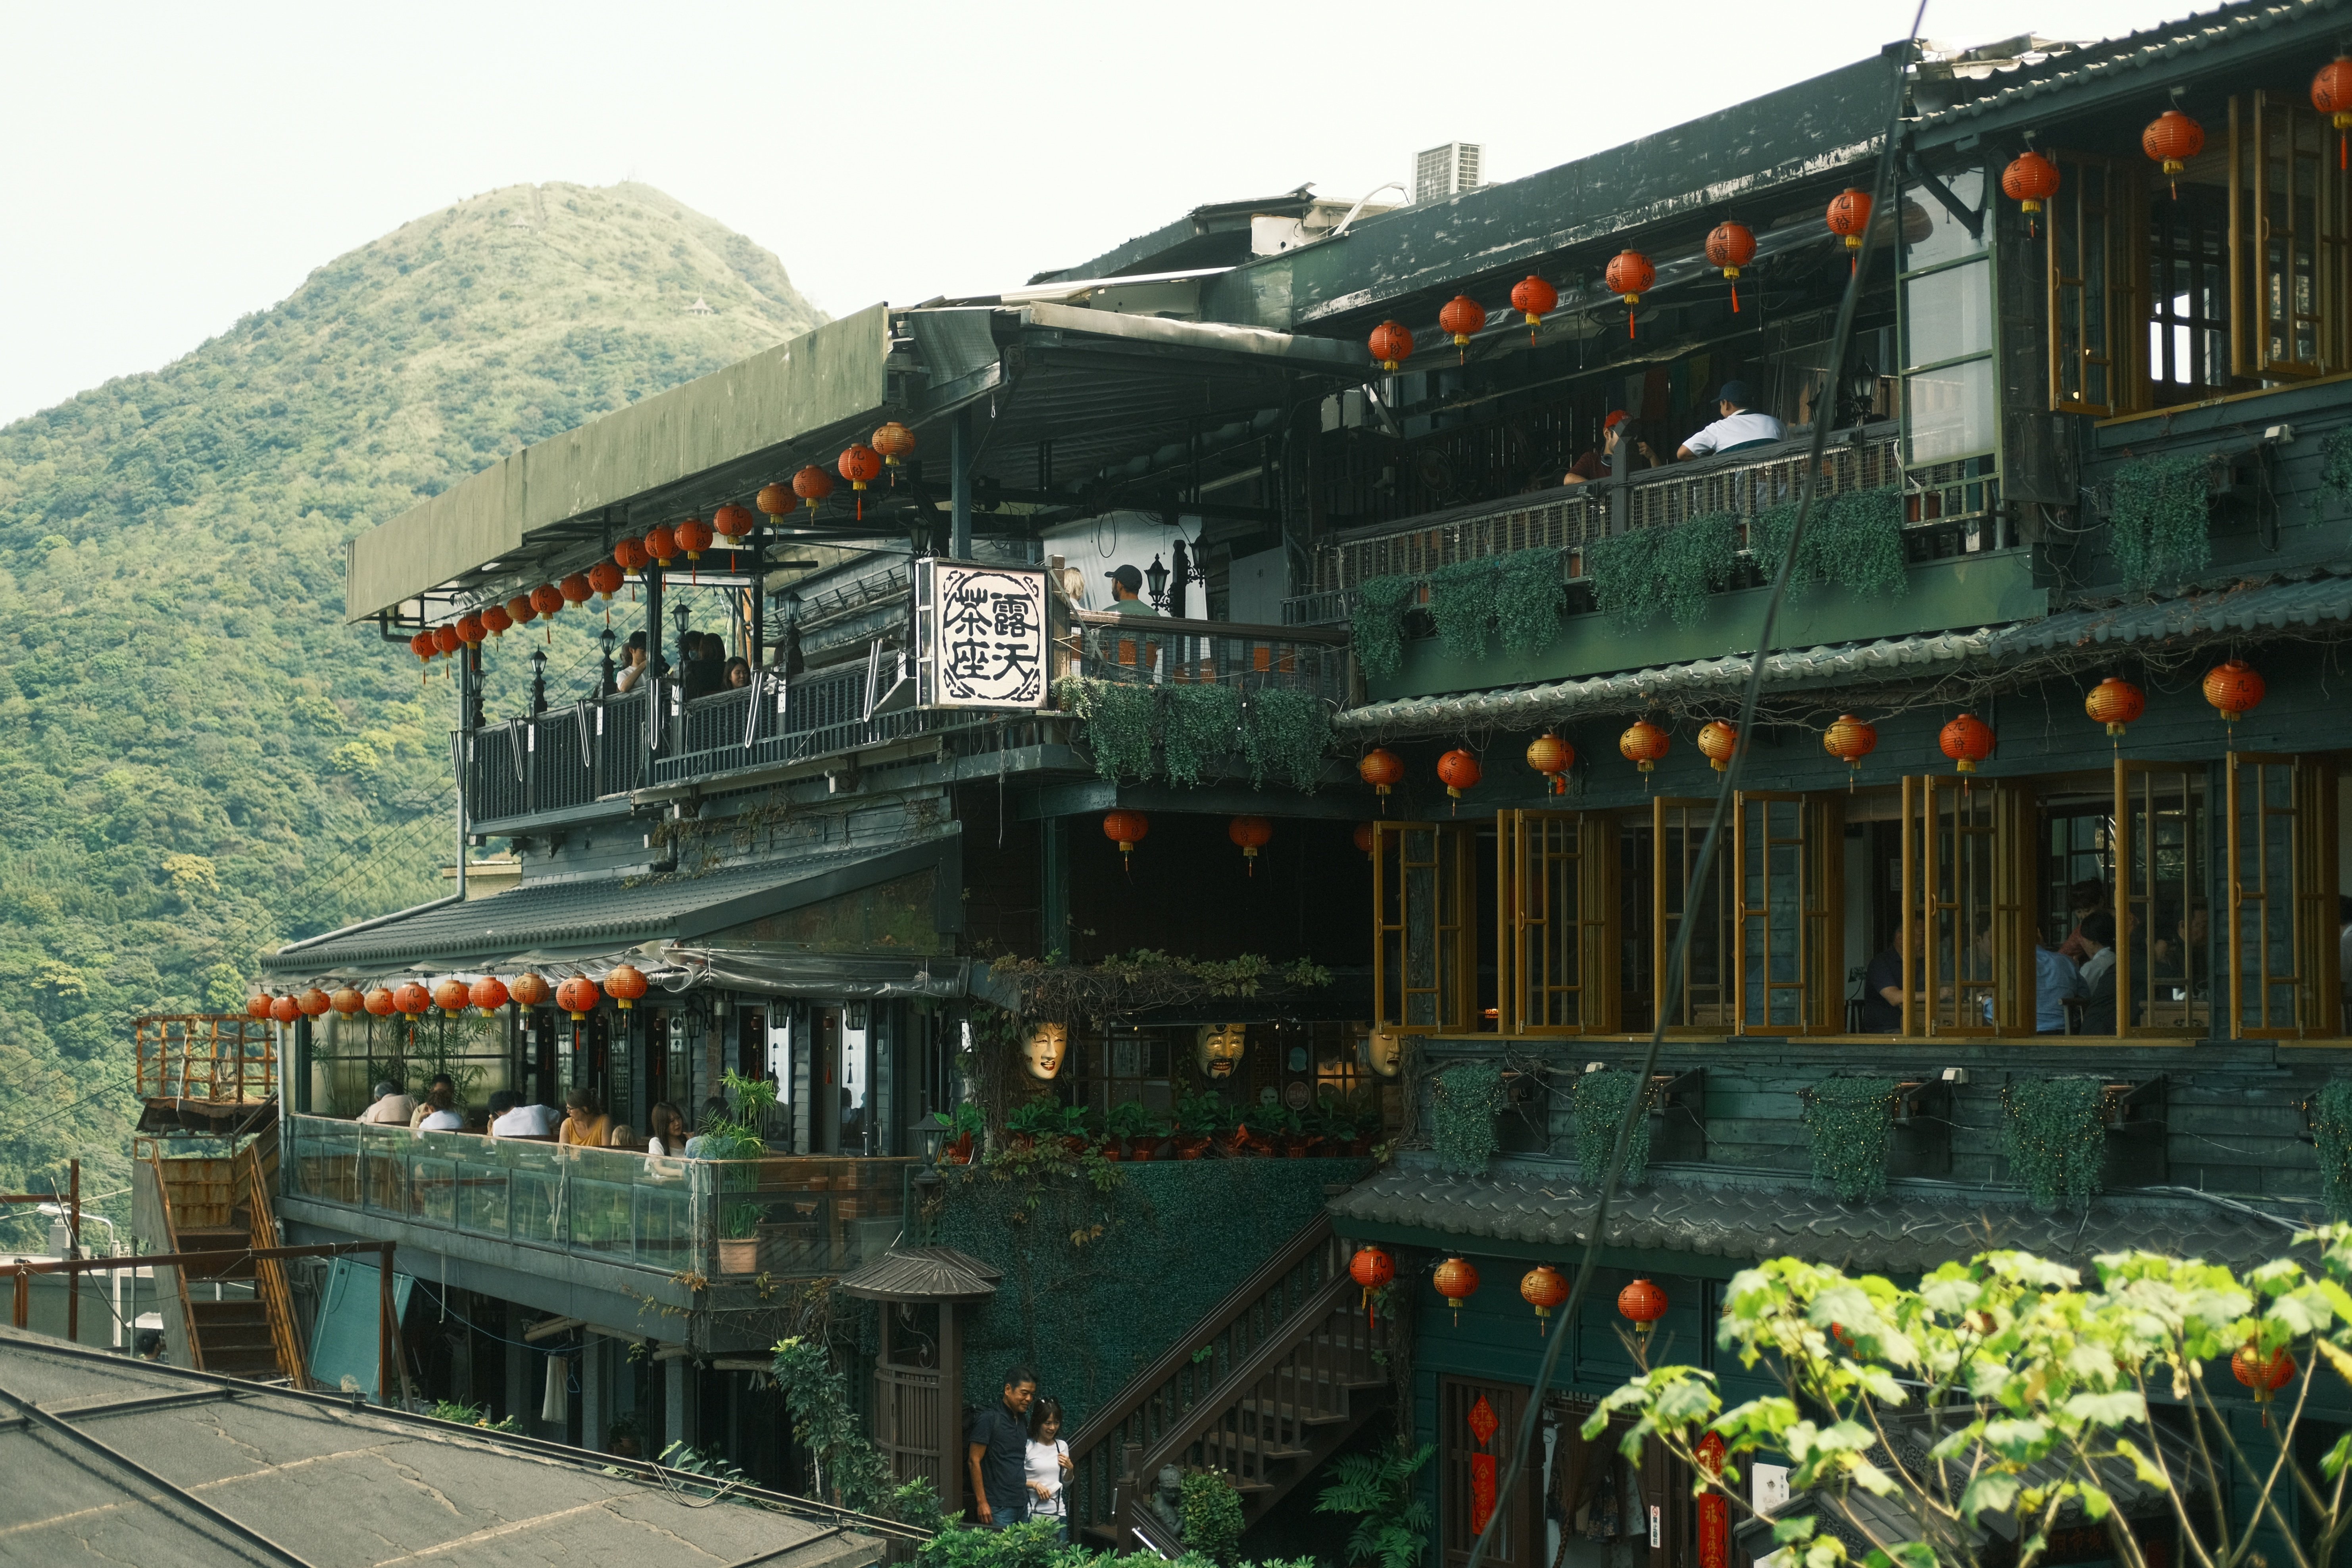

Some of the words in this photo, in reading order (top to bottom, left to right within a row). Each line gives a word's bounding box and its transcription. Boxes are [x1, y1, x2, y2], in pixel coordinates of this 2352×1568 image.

[2146, 120, 2157, 151] 九份
[2011, 160, 2020, 191] 九份
[1835, 197, 1849, 230] 九份
[1714, 228, 1727, 260] 九份
[1610, 259, 1622, 287] 九份
[1641, 257, 1652, 286] 九份
[1519, 282, 1529, 306] 九份
[1469, 302, 1478, 326] 九份
[1389, 326, 1402, 355] 九份
[876, 429, 883, 450] 九份
[852, 451, 865, 477] 九份
[799, 471, 806, 492] 九份
[780, 489, 787, 508] 九份
[732, 509, 743, 532] 九份
[648, 533, 657, 555] 九份
[696, 524, 705, 547] 九份
[628, 542, 638, 564] 九份
[594, 569, 602, 590] 九份
[540, 589, 548, 610] 九份
[469, 619, 477, 639] 九份
[489, 609, 496, 627] 九份
[417, 636, 425, 654] 九份
[947, 588, 992, 680] 茶座
[990, 592, 1038, 683] 露天
[2089, 688, 2098, 716] 九份
[2127, 686, 2137, 715] 九份
[2236, 680, 2248, 709] 九份
[1623, 729, 1631, 754] 九份
[1654, 729, 1664, 753] 九份
[1700, 730, 1709, 752] 九份
[1862, 724, 1871, 749] 九份
[1954, 723, 1965, 750] 九份
[1528, 743, 1536, 768] 九份
[1445, 756, 1457, 781] 九份
[1132, 814, 1139, 836] 九份
[1239, 817, 1249, 840] 九份
[492, 984, 500, 1004] 九份
[519, 981, 528, 1000] 九份
[637, 972, 644, 995] 九份
[254, 999, 259, 1015] 九份
[317, 995, 324, 1012] 九份
[351, 992, 358, 1009] 九份
[380, 995, 388, 1013] 九份
[408, 988, 419, 1011] 九份
[451, 987, 459, 1006] 九份
[563, 984, 576, 1008] 九份
[291, 1001, 299, 1021] 九份
[1373, 1256, 1386, 1284] 九份
[1435, 1268, 1443, 1293] 九份
[1464, 1268, 1473, 1293] 九份
[1524, 1276, 1533, 1301] 九份
[1555, 1280, 1564, 1303] 九份
[1622, 1290, 1630, 1316] 九份
[1652, 1291, 1662, 1318] 九份
